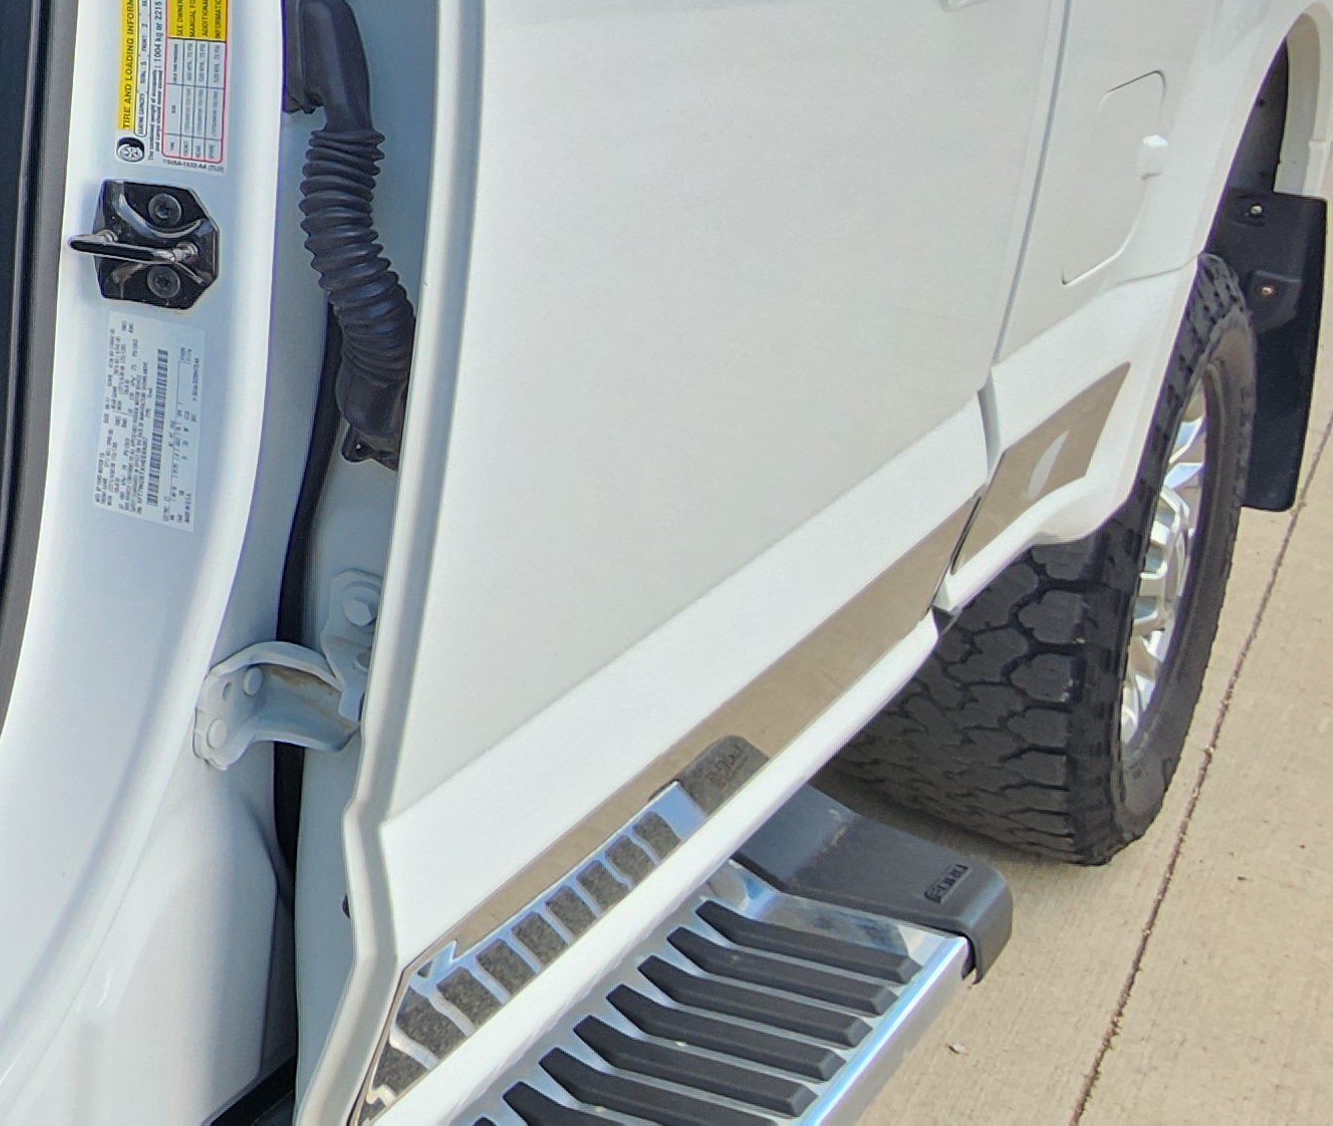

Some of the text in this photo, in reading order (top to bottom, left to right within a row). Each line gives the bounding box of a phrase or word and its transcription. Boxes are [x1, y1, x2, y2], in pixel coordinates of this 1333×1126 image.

[154, 3, 162, 20] 2215
[154, 32, 163, 43] kg
[124, 37, 134, 81] LOADING
[154, 44, 162, 61] 1004
[123, 83, 132, 105] AND
[122, 106, 131, 129] TIRE
